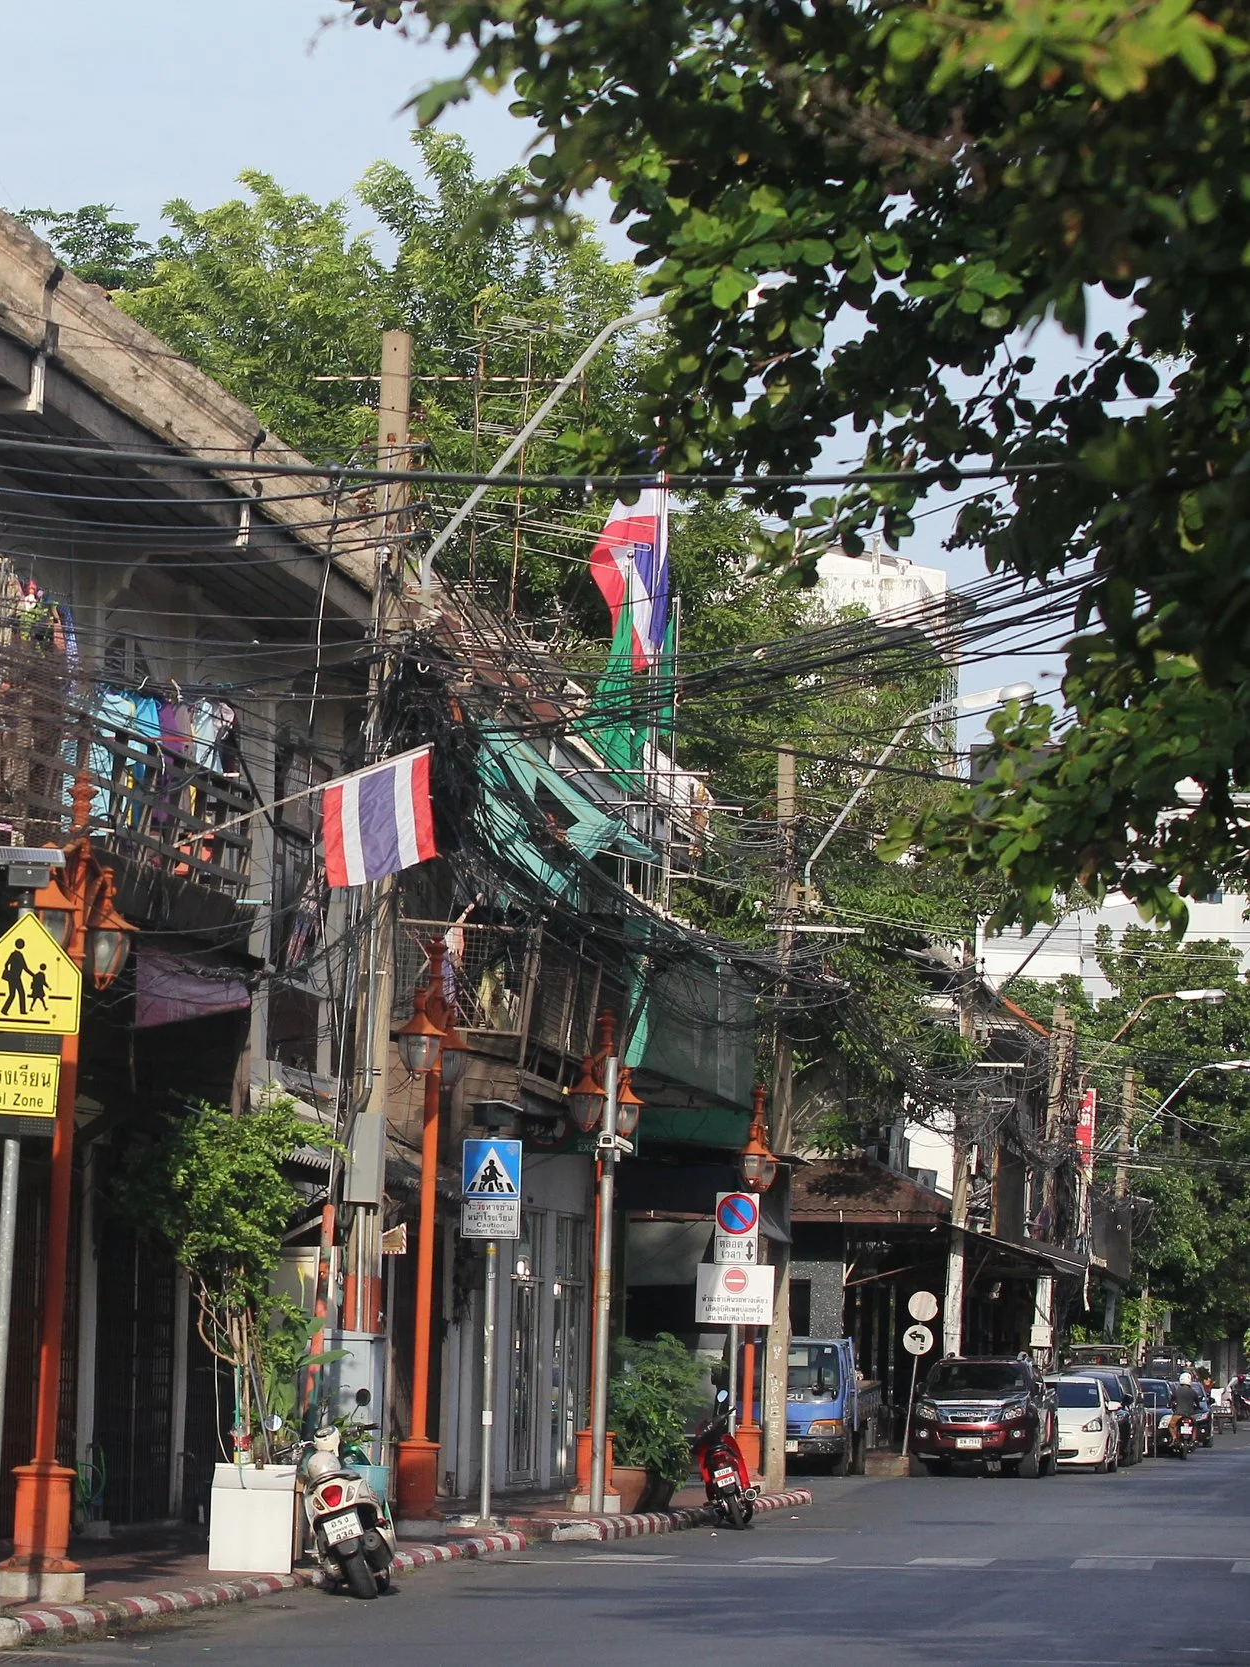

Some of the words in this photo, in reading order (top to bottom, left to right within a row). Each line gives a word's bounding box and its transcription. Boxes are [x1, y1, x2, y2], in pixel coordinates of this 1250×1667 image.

[13, 1093, 44, 1108] Zone
[719, 1240, 744, 1249] ตลอด
[721, 1250, 741, 1259] เวลา
